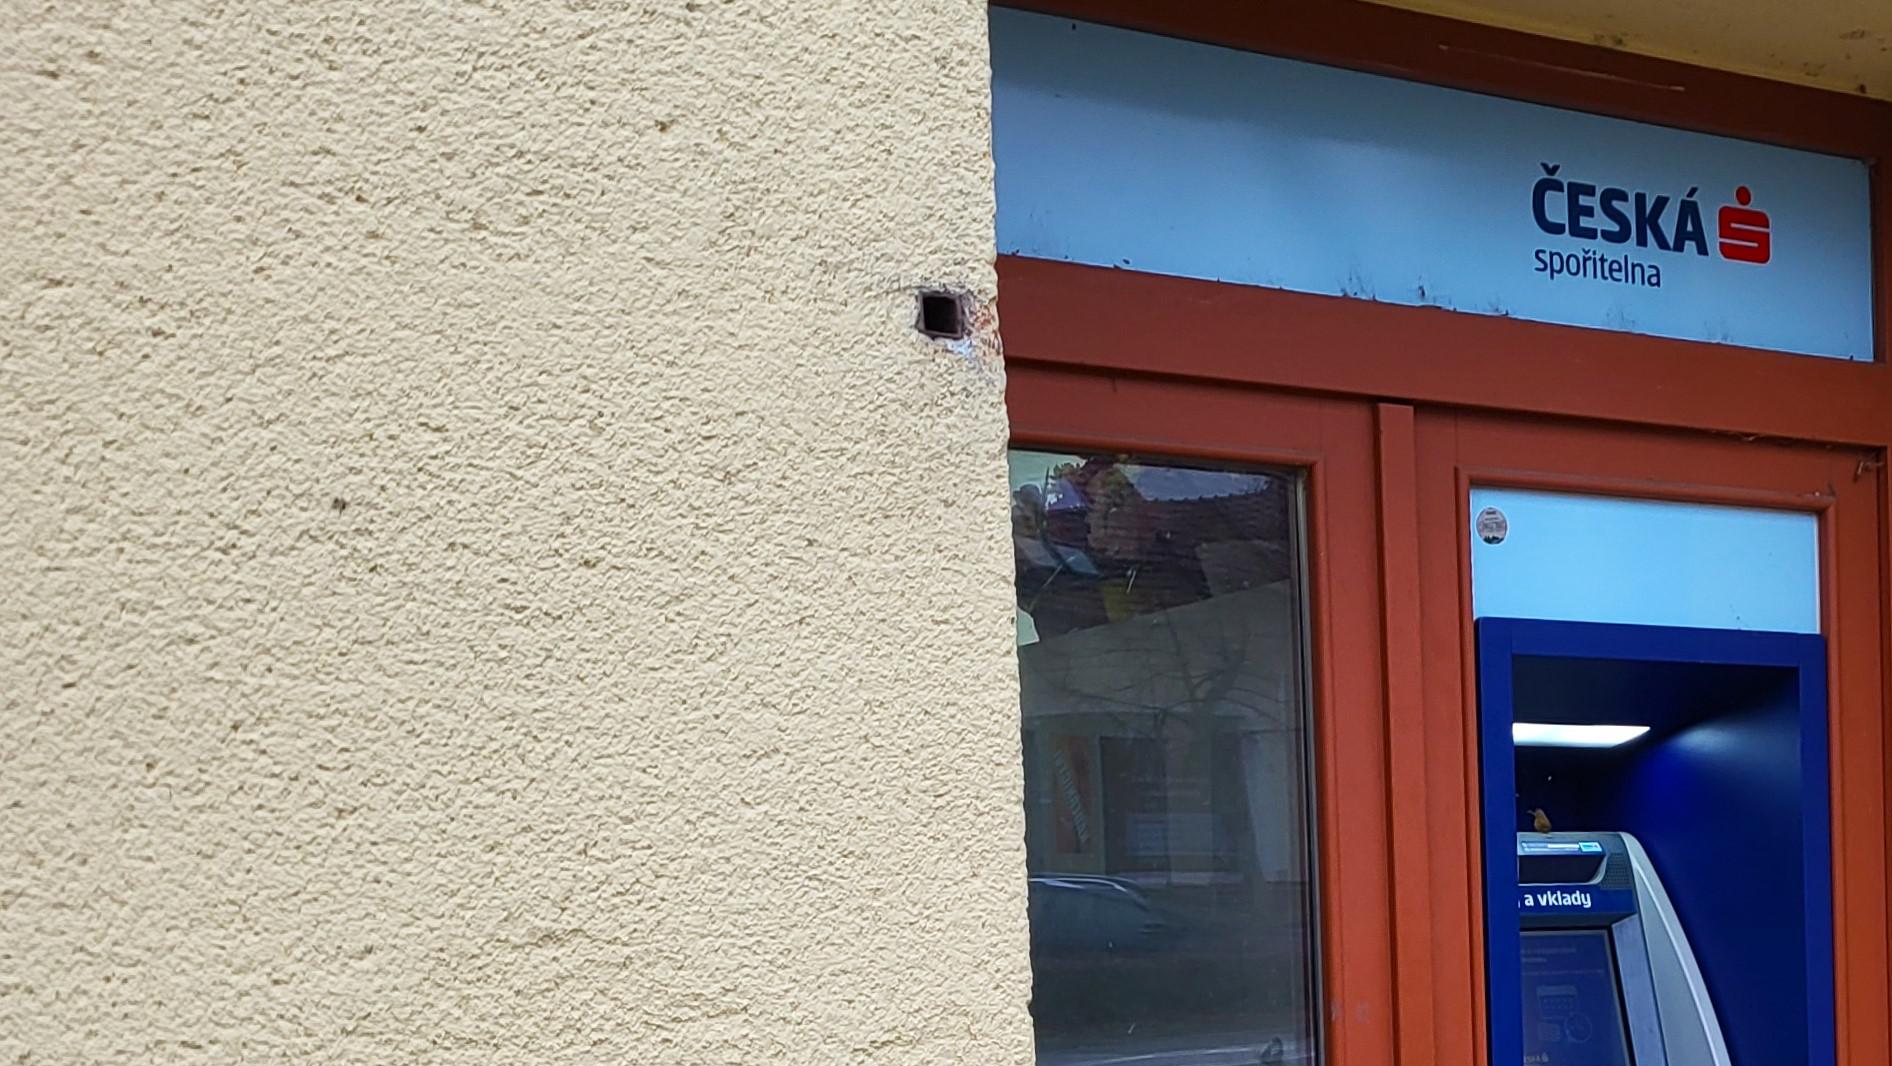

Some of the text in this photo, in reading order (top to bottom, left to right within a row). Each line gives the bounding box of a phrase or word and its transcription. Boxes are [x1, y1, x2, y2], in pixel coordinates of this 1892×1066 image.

[1532, 162, 1709, 257] ČESKÁ
[1534, 249, 1661, 288] spořitelna
[1524, 890, 1592, 908] a vklady
